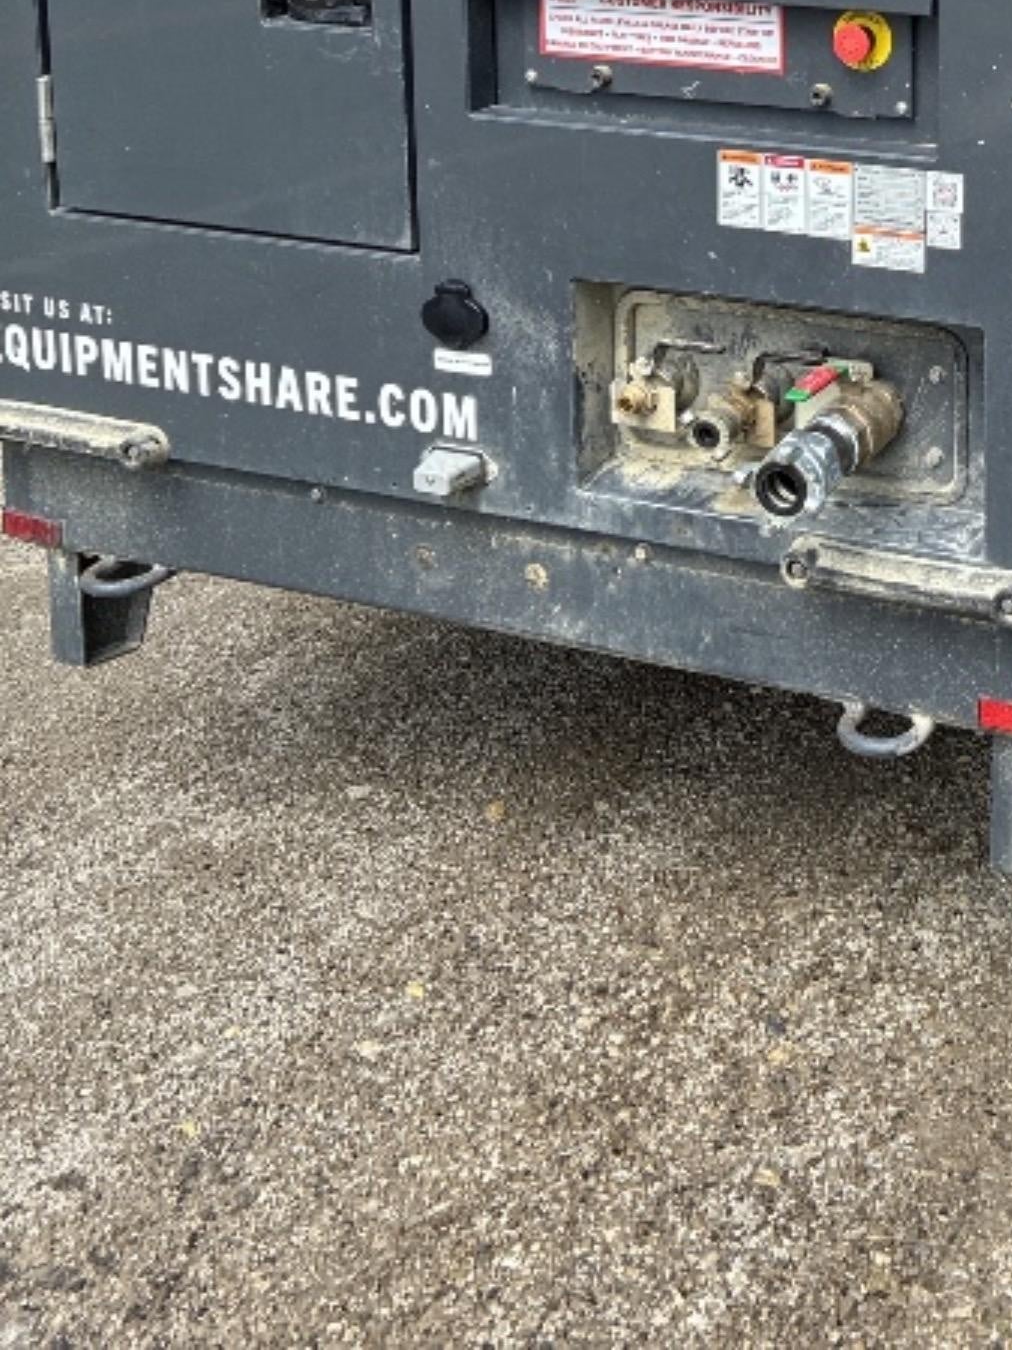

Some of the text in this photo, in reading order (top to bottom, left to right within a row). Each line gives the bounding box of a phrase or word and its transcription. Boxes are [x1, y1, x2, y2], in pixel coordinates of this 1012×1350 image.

[44, 296, 70, 319] US
[80, 303, 112, 325] AT:
[0, 323, 478, 441] QUIPMENTSHARE.COM
